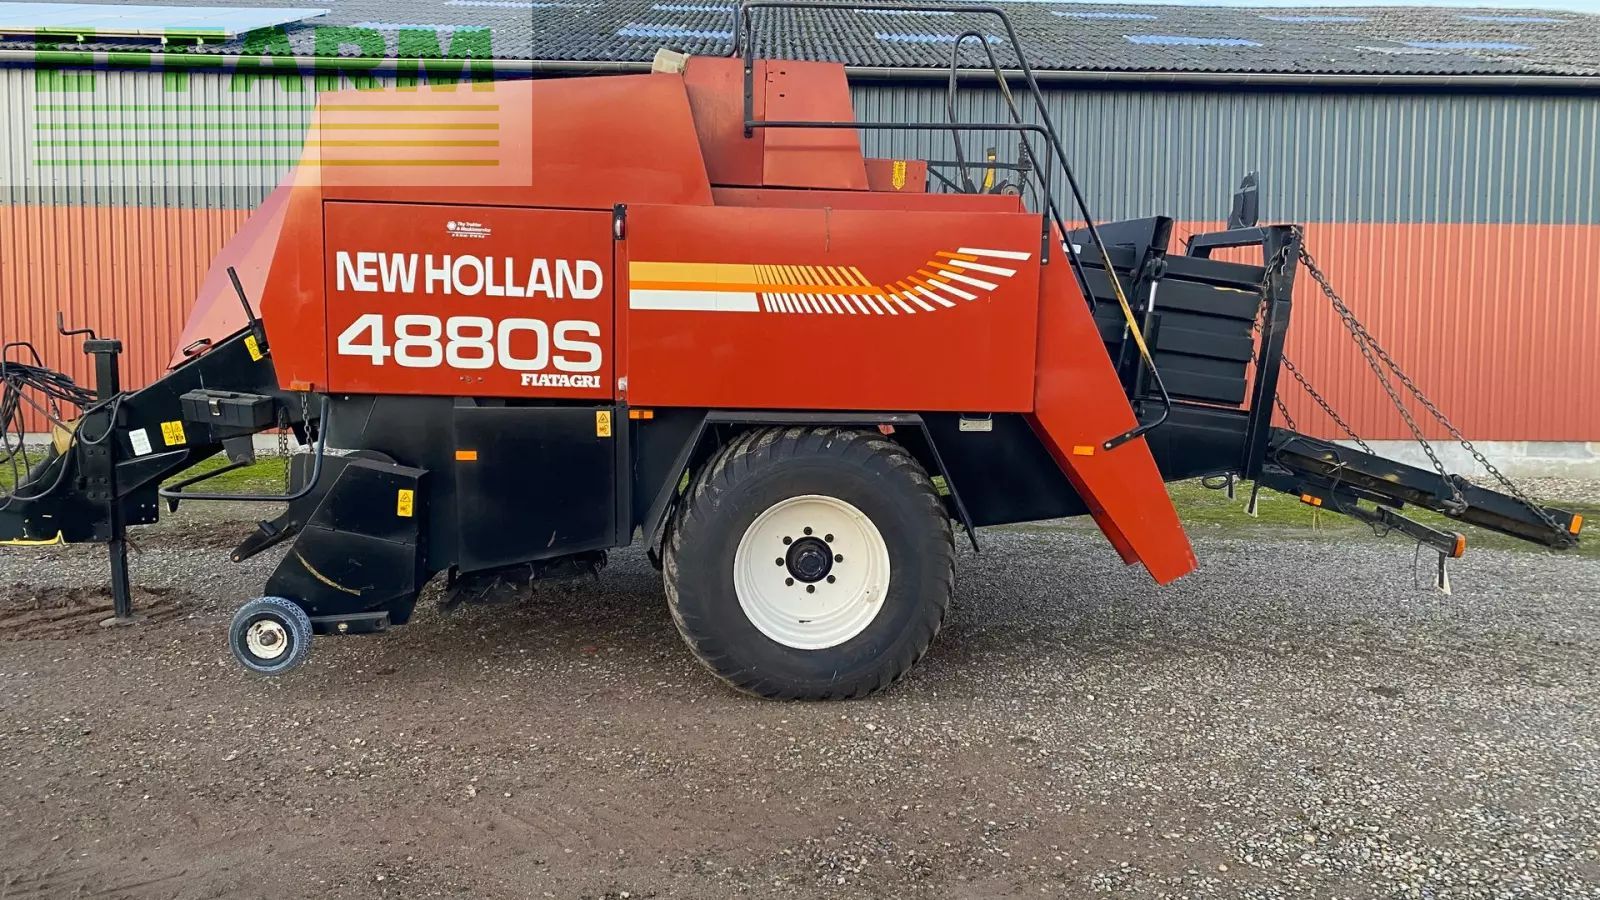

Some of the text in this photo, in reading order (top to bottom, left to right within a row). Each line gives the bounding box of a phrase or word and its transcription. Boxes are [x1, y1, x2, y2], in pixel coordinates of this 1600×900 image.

[336, 251, 603, 300] NEW HOLLAND
[337, 313, 602, 372] 4880S
[520, 373, 600, 388] FIATAGRI
